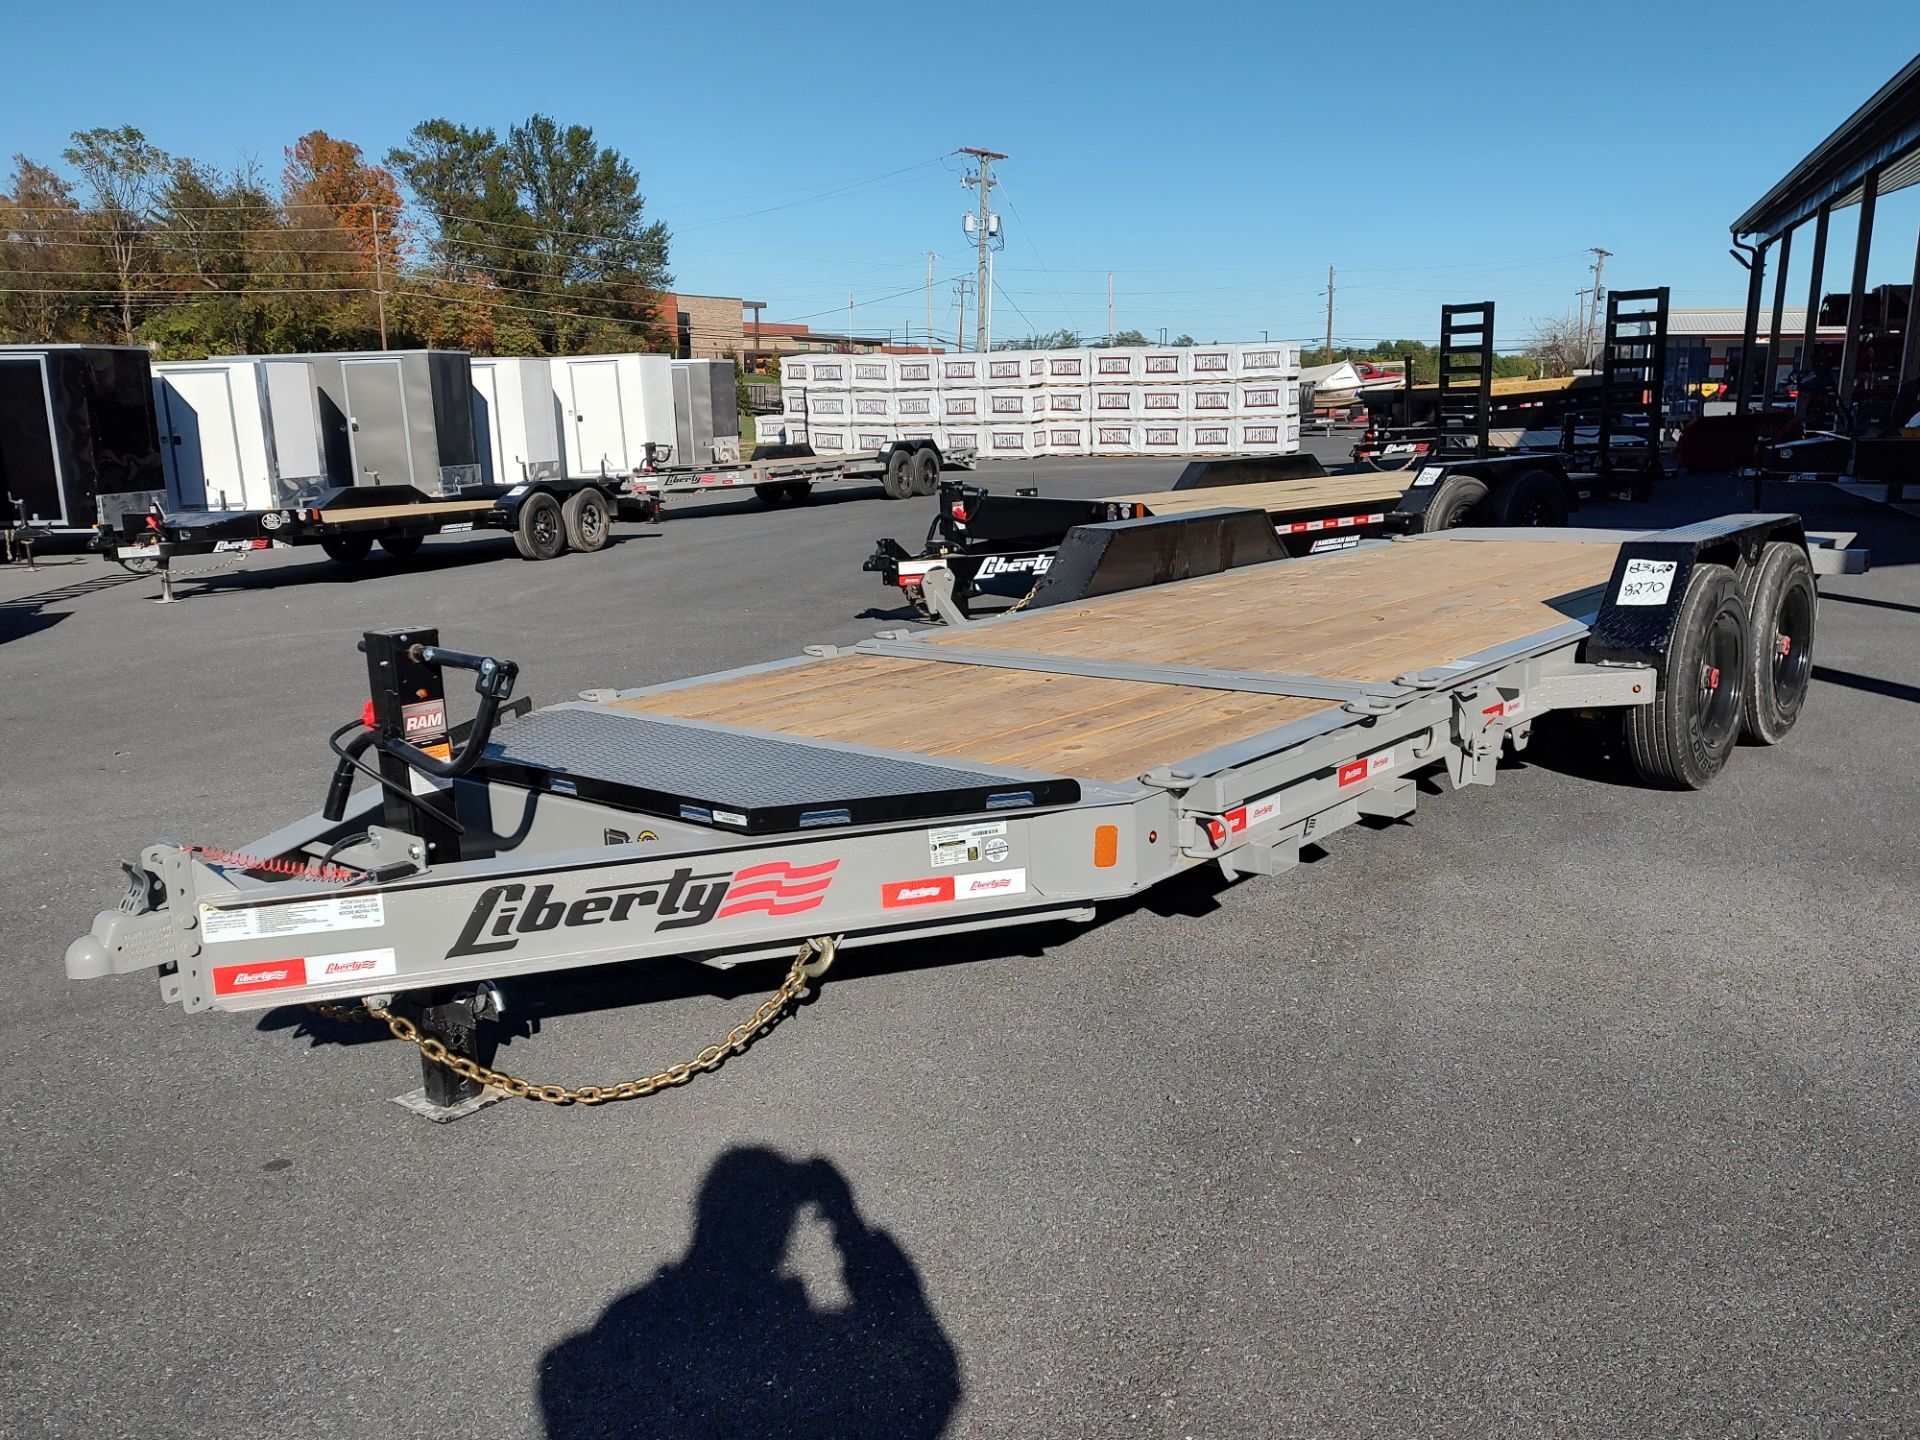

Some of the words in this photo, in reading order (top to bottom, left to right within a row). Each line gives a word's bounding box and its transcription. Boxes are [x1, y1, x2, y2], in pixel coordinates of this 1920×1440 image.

[1101, 358, 1129, 372] WESTERN
[1147, 358, 1178, 371] WESTERN
[1196, 355, 1227, 370] WESTERN
[1244, 353, 1280, 368] WESTERN
[1101, 394, 1129, 408] WESTERN
[1146, 395, 1178, 408] WESTERN
[1197, 393, 1228, 408] WESTERN
[1246, 391, 1277, 406] WESTERN
[1148, 430, 1178, 444] WESTERN
[1197, 429, 1227, 444] WESTERN
[1246, 428, 1277, 442] WESTERN
[664, 474, 701, 486] Liberty
[213, 540, 252, 553] Liberty
[974, 554, 1055, 579] Liberty
[1624, 581, 1665, 597] 8270
[406, 712, 443, 732] RAM
[445, 867, 733, 960] Liberty
[325, 962, 361, 975] Liberty
[233, 971, 274, 985] Liberty
